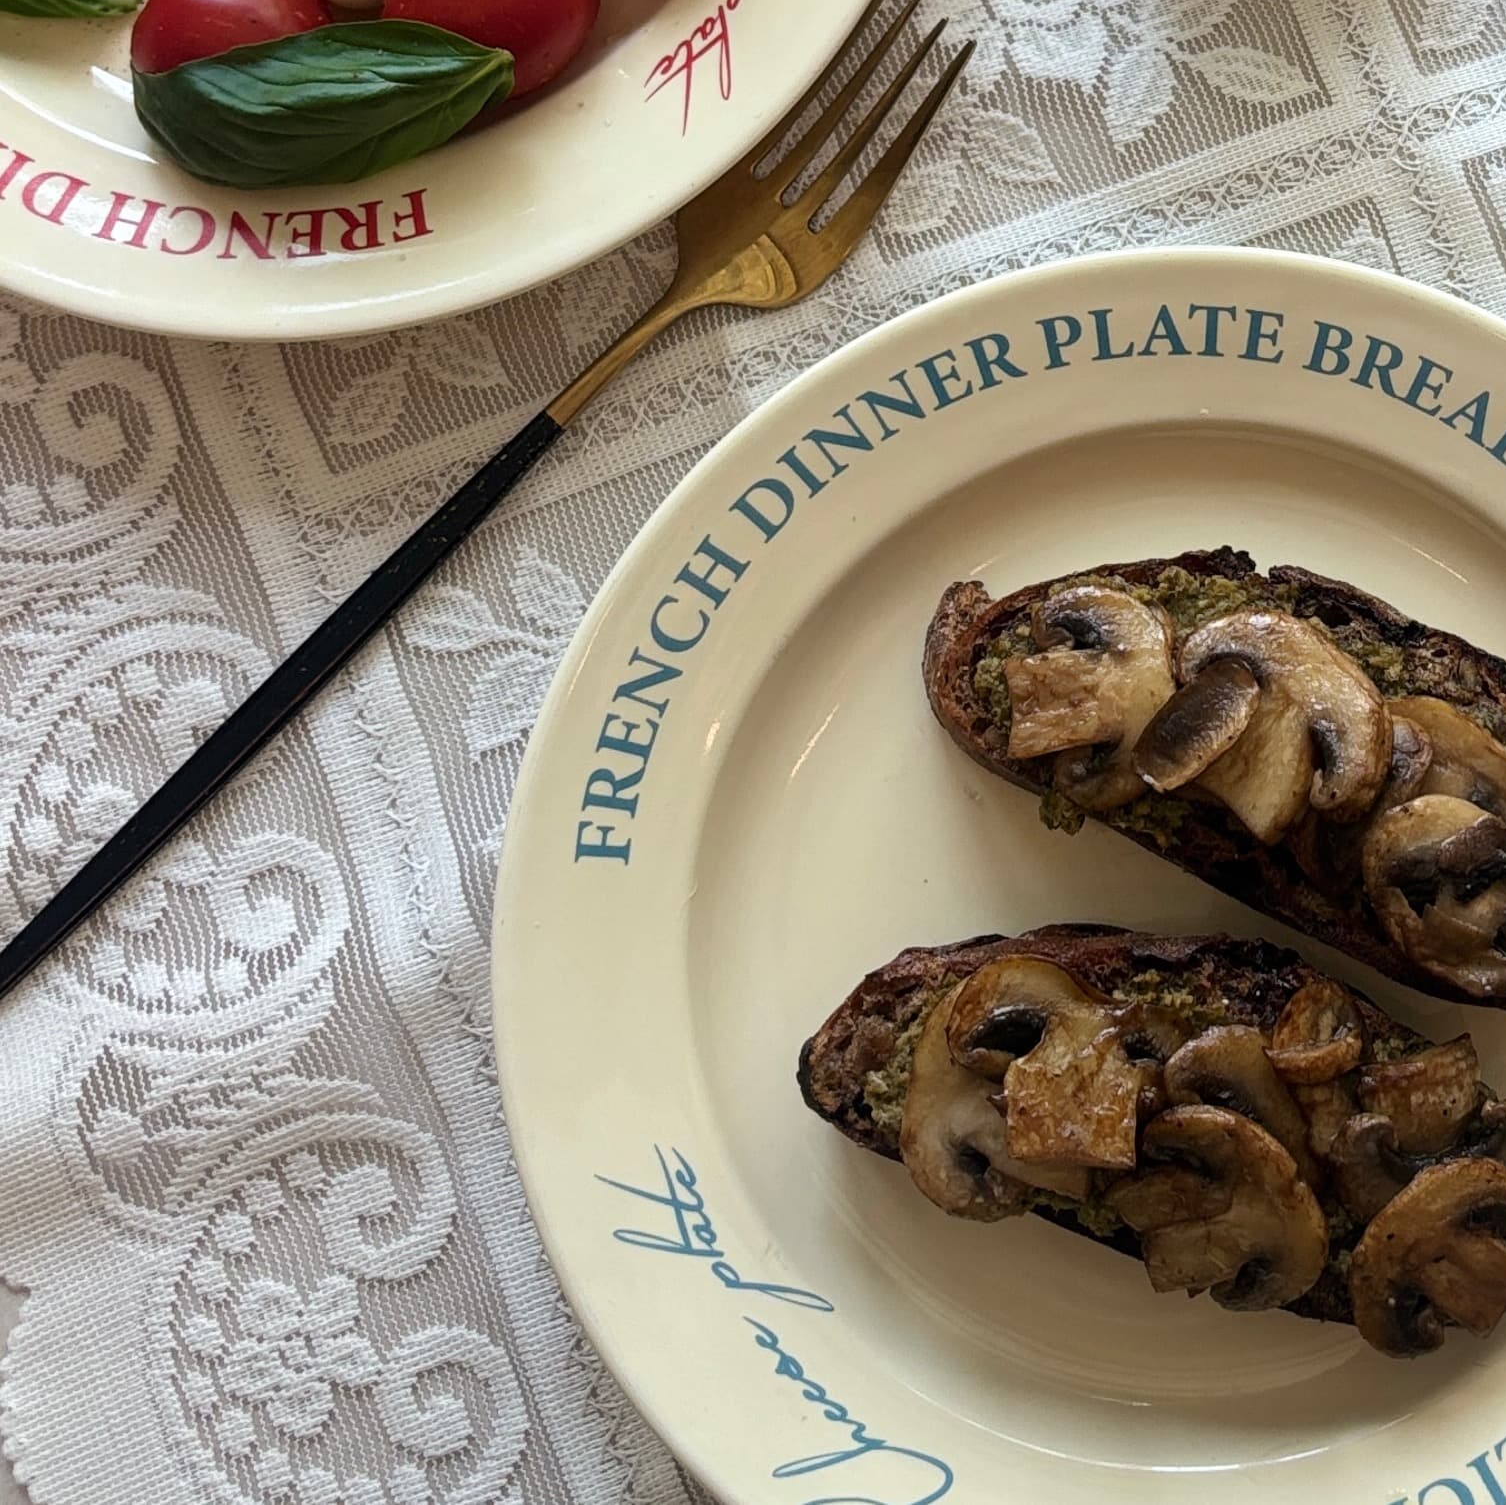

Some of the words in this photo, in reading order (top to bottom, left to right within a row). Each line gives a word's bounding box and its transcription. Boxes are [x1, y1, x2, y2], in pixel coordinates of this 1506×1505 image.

[0, 141, 90, 225] DI
[92, 188, 434, 260] FRENCH
[574, 534, 751, 865] FRENCH
[729, 333, 1027, 544] DINNER
[1035, 303, 1285, 370] PLATE
[593, 1144, 835, 1311] plate
